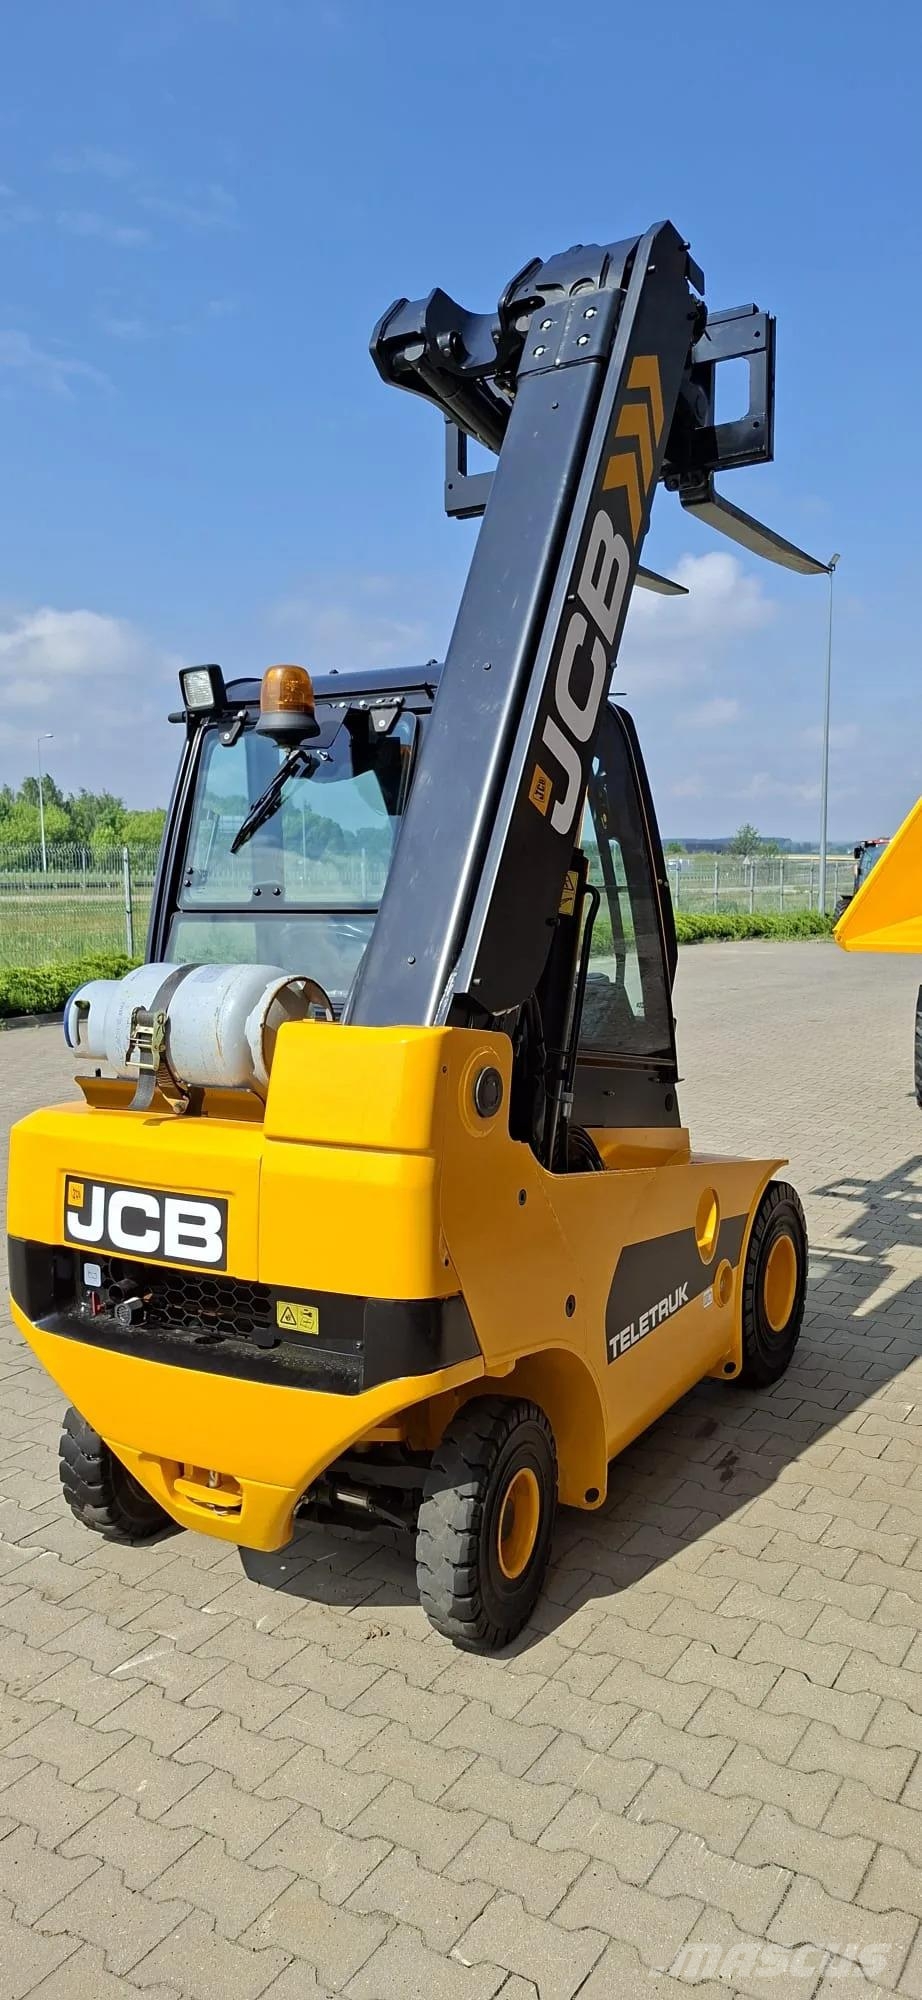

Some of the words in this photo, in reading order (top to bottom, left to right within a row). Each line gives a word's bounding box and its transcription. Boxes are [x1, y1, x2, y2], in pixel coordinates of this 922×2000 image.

[542, 509, 631, 835] JCB
[66, 1185, 223, 1263] JCB
[608, 1281, 689, 1358] TELETRUK
